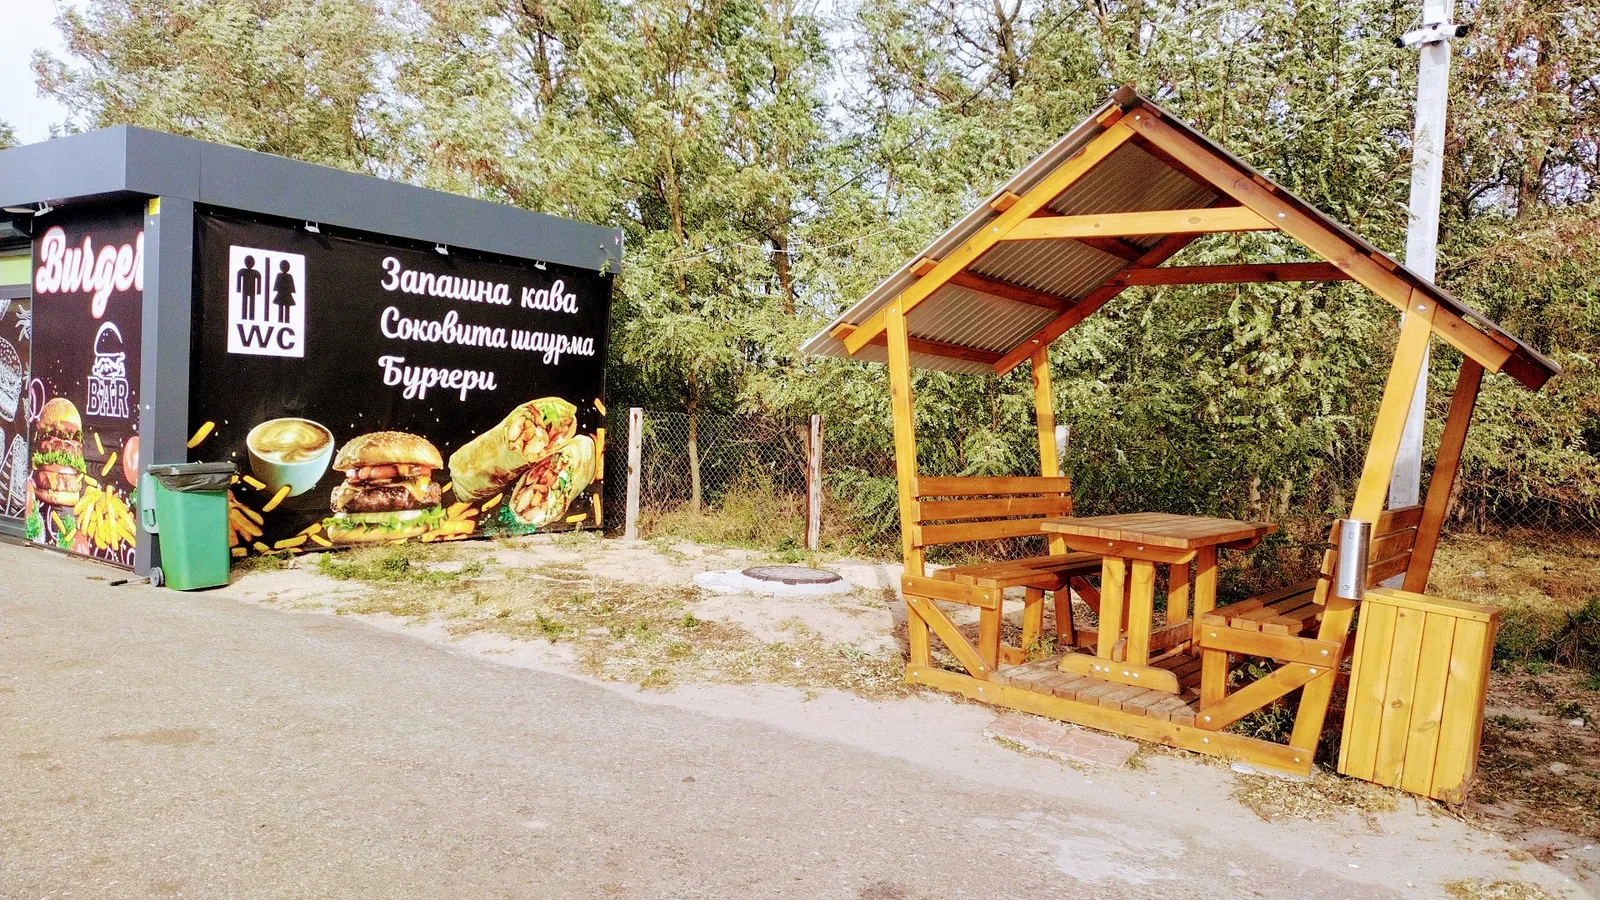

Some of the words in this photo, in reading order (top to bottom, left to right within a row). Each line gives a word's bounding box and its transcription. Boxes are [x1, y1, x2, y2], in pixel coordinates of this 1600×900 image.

[380, 256, 511, 306] Запашна
[521, 279, 579, 314] кава
[236, 323, 296, 350] WC
[380, 306, 508, 348] Соковита
[511, 331, 595, 365] шаурма
[86, 375, 129, 418] BAR
[378, 355, 497, 402] Бургери
